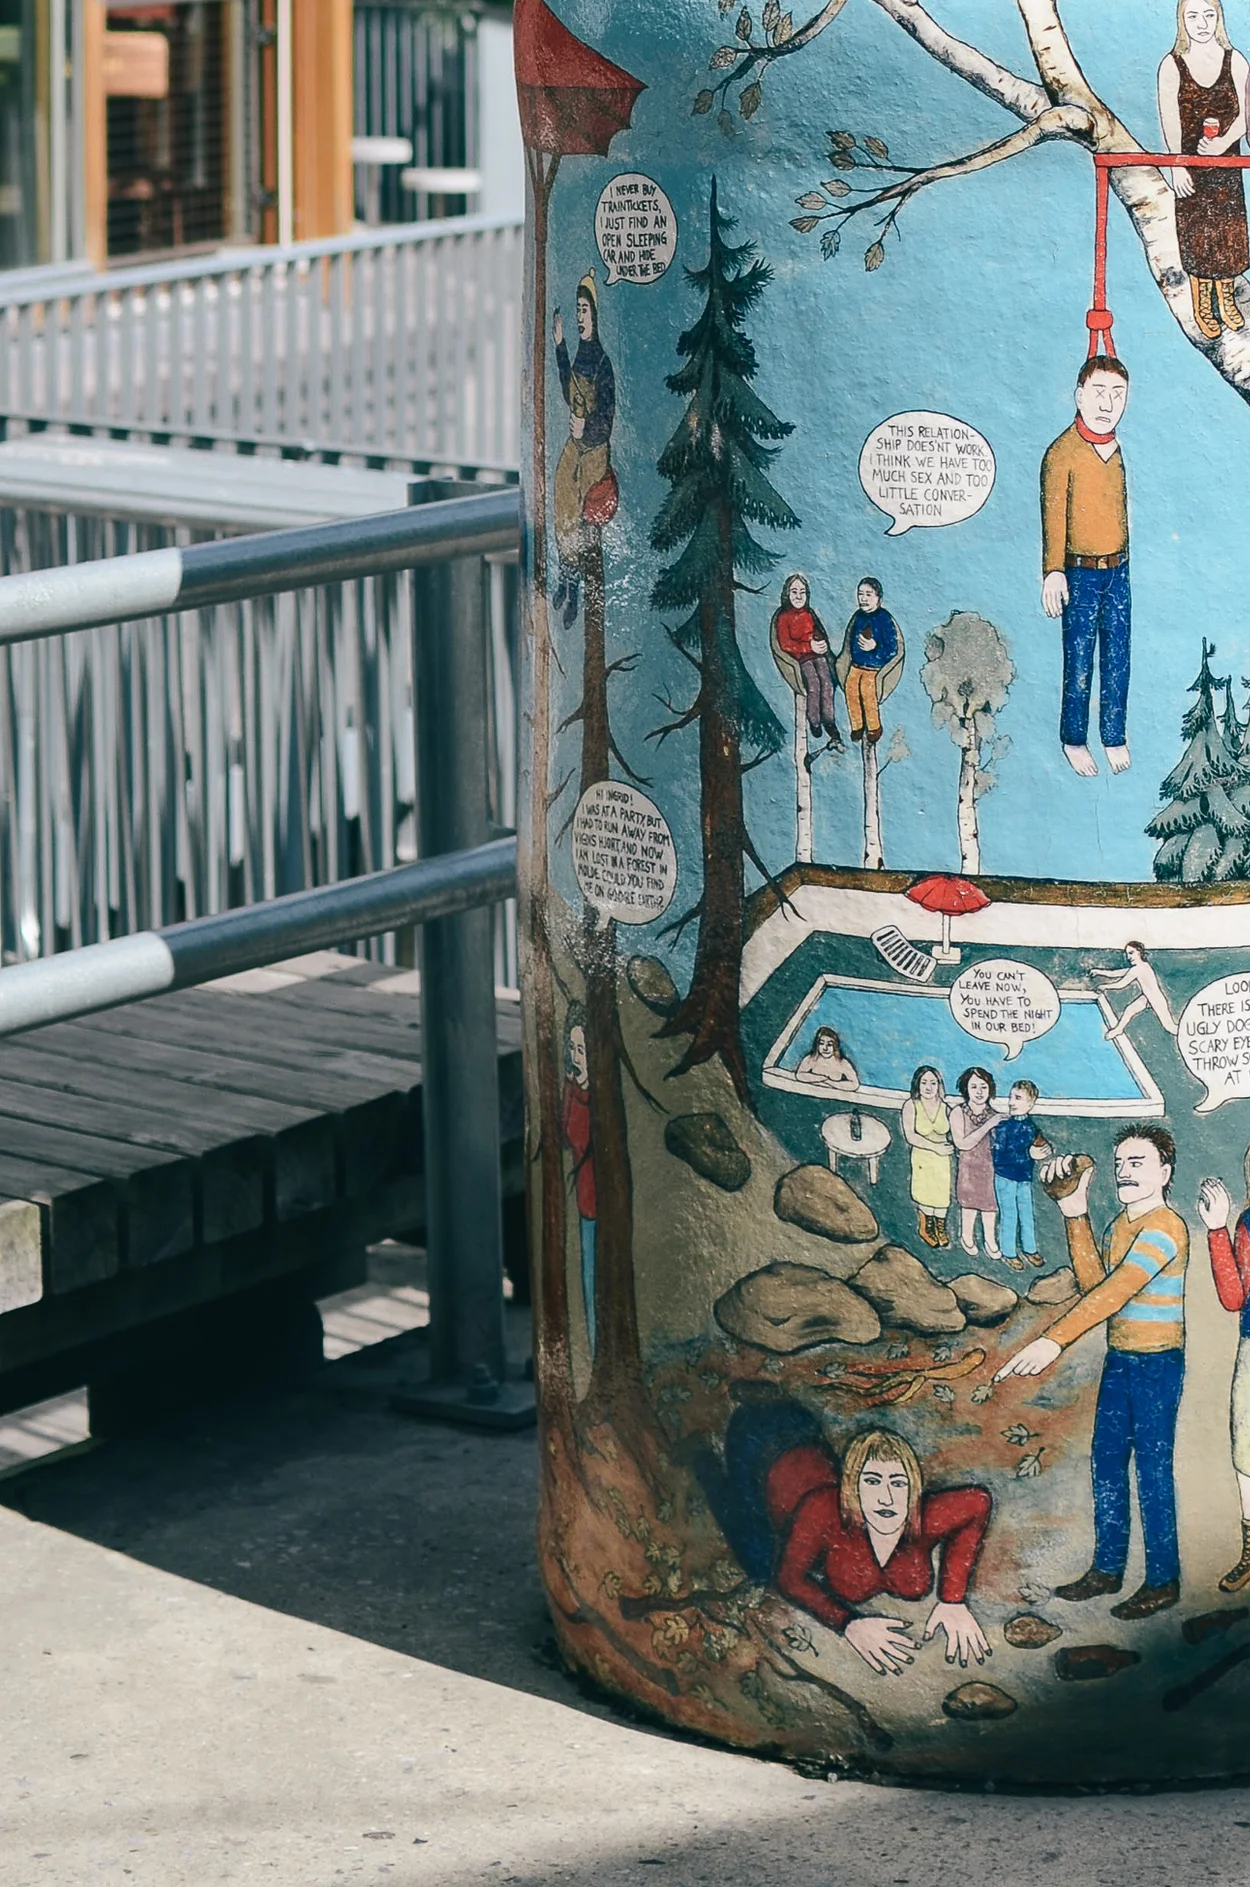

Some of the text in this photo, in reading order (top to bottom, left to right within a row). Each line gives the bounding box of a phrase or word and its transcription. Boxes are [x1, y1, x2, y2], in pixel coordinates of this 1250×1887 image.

[616, 184, 639, 195] NEVER
[642, 184, 656, 197] BUY
[605, 217, 625, 230] JUST
[629, 216, 648, 228] FIND
[654, 216, 667, 228] AN
[602, 232, 667, 247] OPEN SLEEPING
[603, 249, 656, 264] CAR AND HIDE
[617, 262, 665, 277] UNDER THE BED
[888, 425, 975, 440] THIS RELATION-
[876, 438, 901, 450] SHIP
[876, 454, 911, 468] THINK
[916, 457, 934, 468] WE
[940, 457, 968, 468] HAVE
[972, 458, 992, 472] TOO
[872, 468, 988, 487] MUCH SEX AND TOO
[879, 486, 972, 501] LITTLE CONVER-
[900, 503, 942, 516] SATION
[596, 789, 604, 801] HI
[586, 805, 599, 815] WAS
[602, 806, 610, 817] AT
[647, 816, 661, 828] BUT
[581, 817, 593, 829] HAD
[595, 819, 602, 831] TO
[604, 820, 618, 834] RUN
[622, 824, 647, 841] AWAY
[649, 832, 670, 847] FROM
[622, 842, 637, 856] AND
[641, 845, 663, 860] NOW
[579, 849, 589, 860] AM
[592, 851, 609, 867] LOST
[627, 858, 656, 873] FOREST
[660, 865, 667, 875] IN
[628, 874, 643, 889] YOU
[646, 877, 664, 891] FIND
[997, 970, 1026, 981] CAN'T
[959, 980, 1026, 994] LEAVE NOW,
[986, 996, 1013, 1006] HAVE
[1018, 997, 1032, 1007] TO
[1197, 1002, 1235, 1017] THERE
[1241, 999, 1250, 1012] IS
[963, 1008, 1053, 1019] SPEND THE NIGHT
[972, 1022, 1036, 1034] IN OUR BED!
[1187, 1020, 1221, 1036] UGLY
[1189, 1038, 1229, 1055] SCARY
[1193, 1055, 1239, 1070] THROW
[1224, 1070, 1241, 1085] AT
